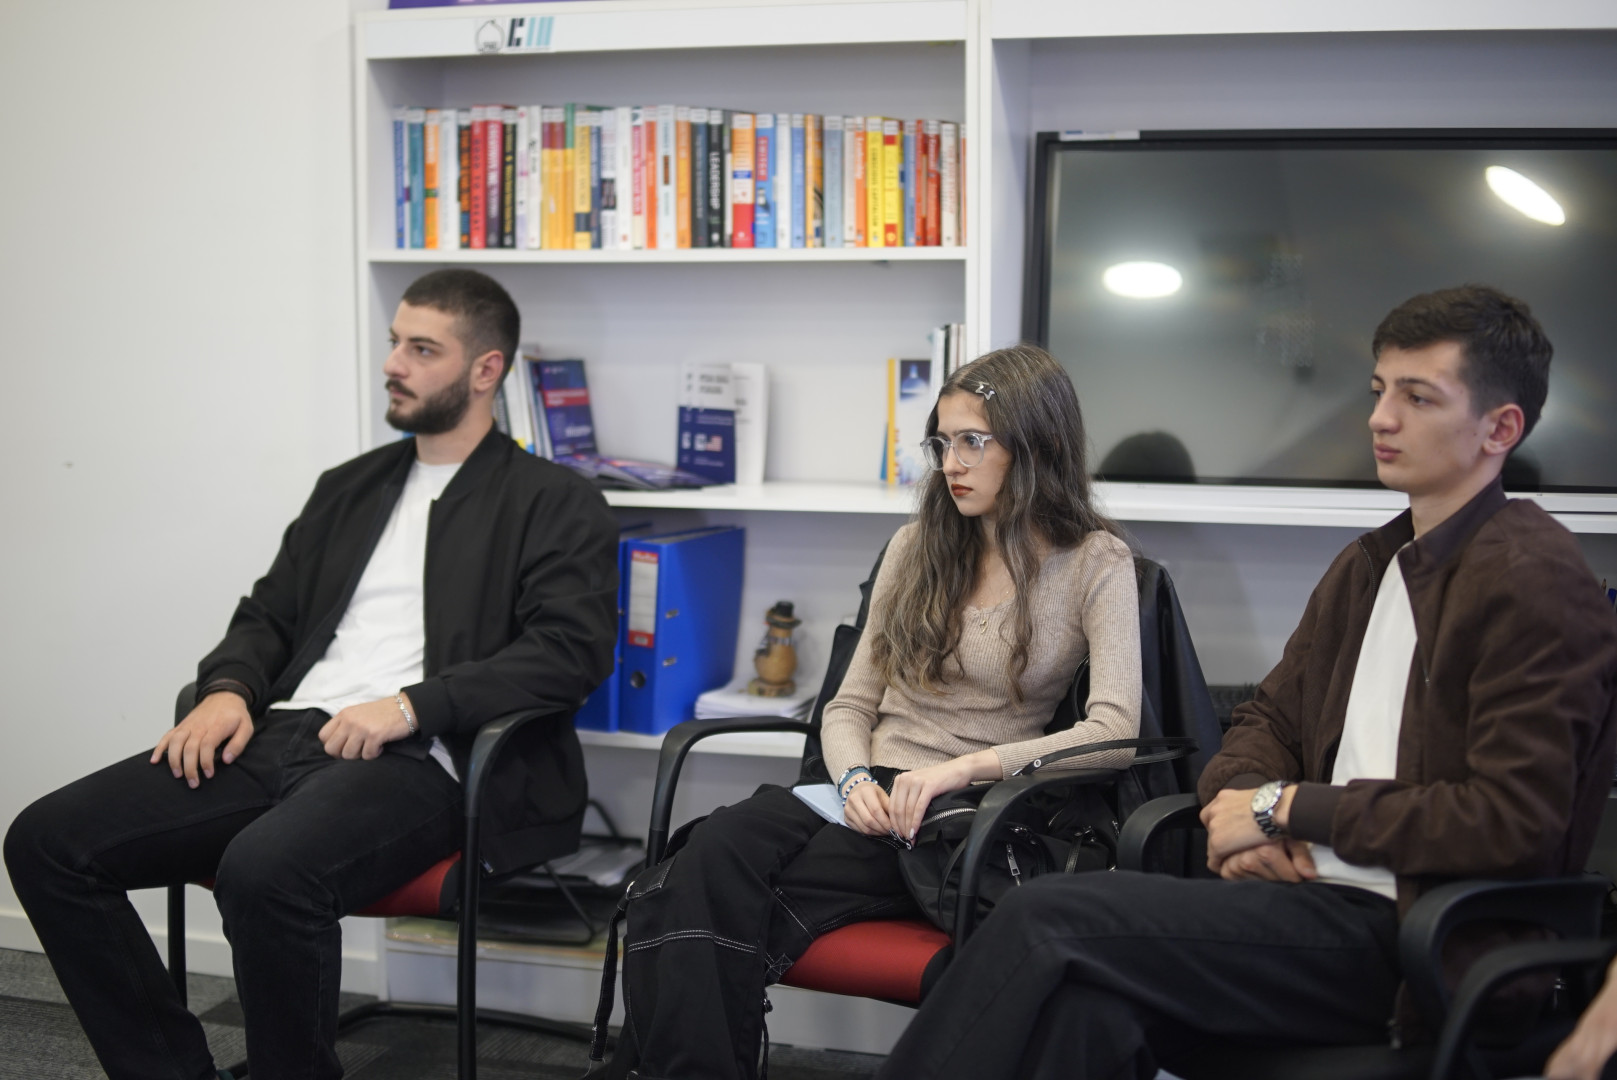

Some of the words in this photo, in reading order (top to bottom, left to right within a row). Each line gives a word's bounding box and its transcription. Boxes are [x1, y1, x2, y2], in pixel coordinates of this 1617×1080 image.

[473, 138, 481, 169] GOOD
[759, 138, 768, 177] SWITCH
[855, 136, 865, 179] Leadership
[473, 175, 481, 189] TO
[709, 151, 720, 210] LEADERSHIP
